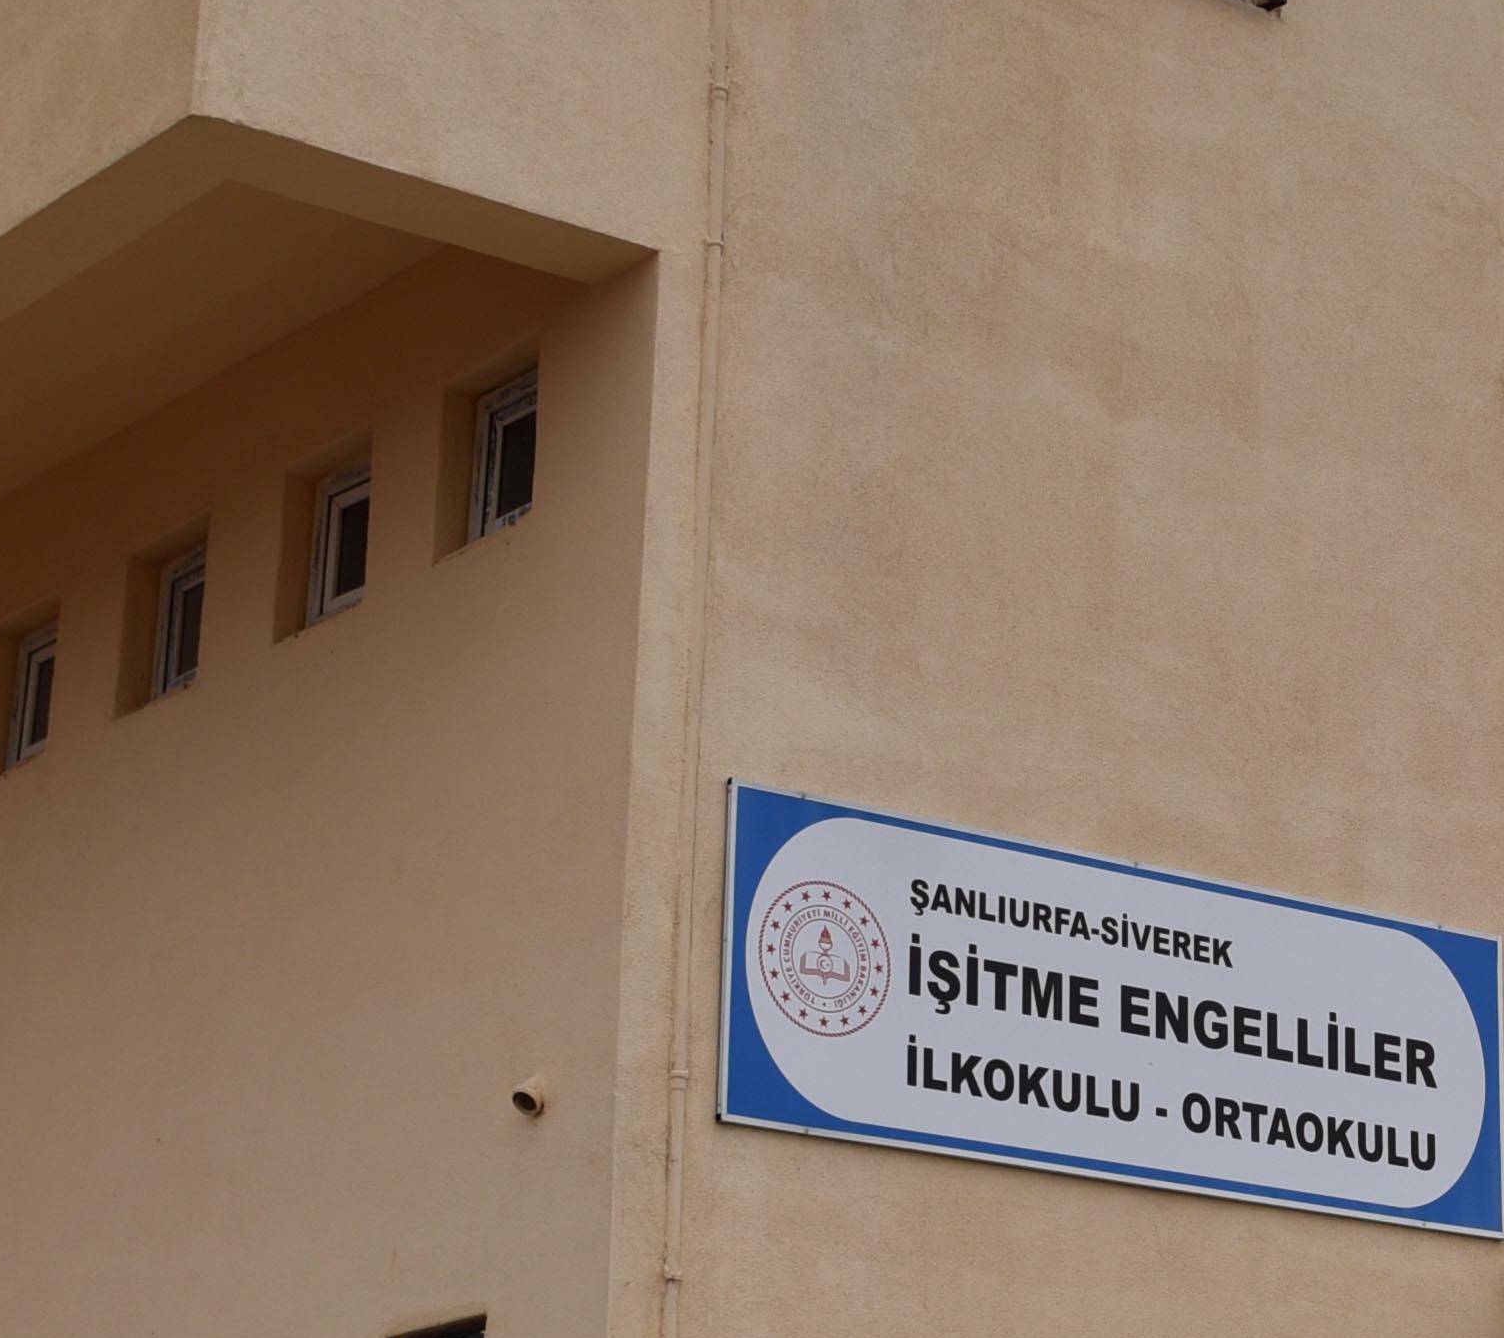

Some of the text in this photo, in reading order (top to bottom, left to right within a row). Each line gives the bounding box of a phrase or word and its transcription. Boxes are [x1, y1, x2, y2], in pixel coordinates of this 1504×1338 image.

[909, 878, 1234, 968] ŞANLIURFA-SİVEREK
[907, 932, 1438, 1090] İŞİTME ENGELLİLER
[905, 1033, 1141, 1124] İLKOKULU
[1181, 1091, 1437, 1172] ORTAOKULU
